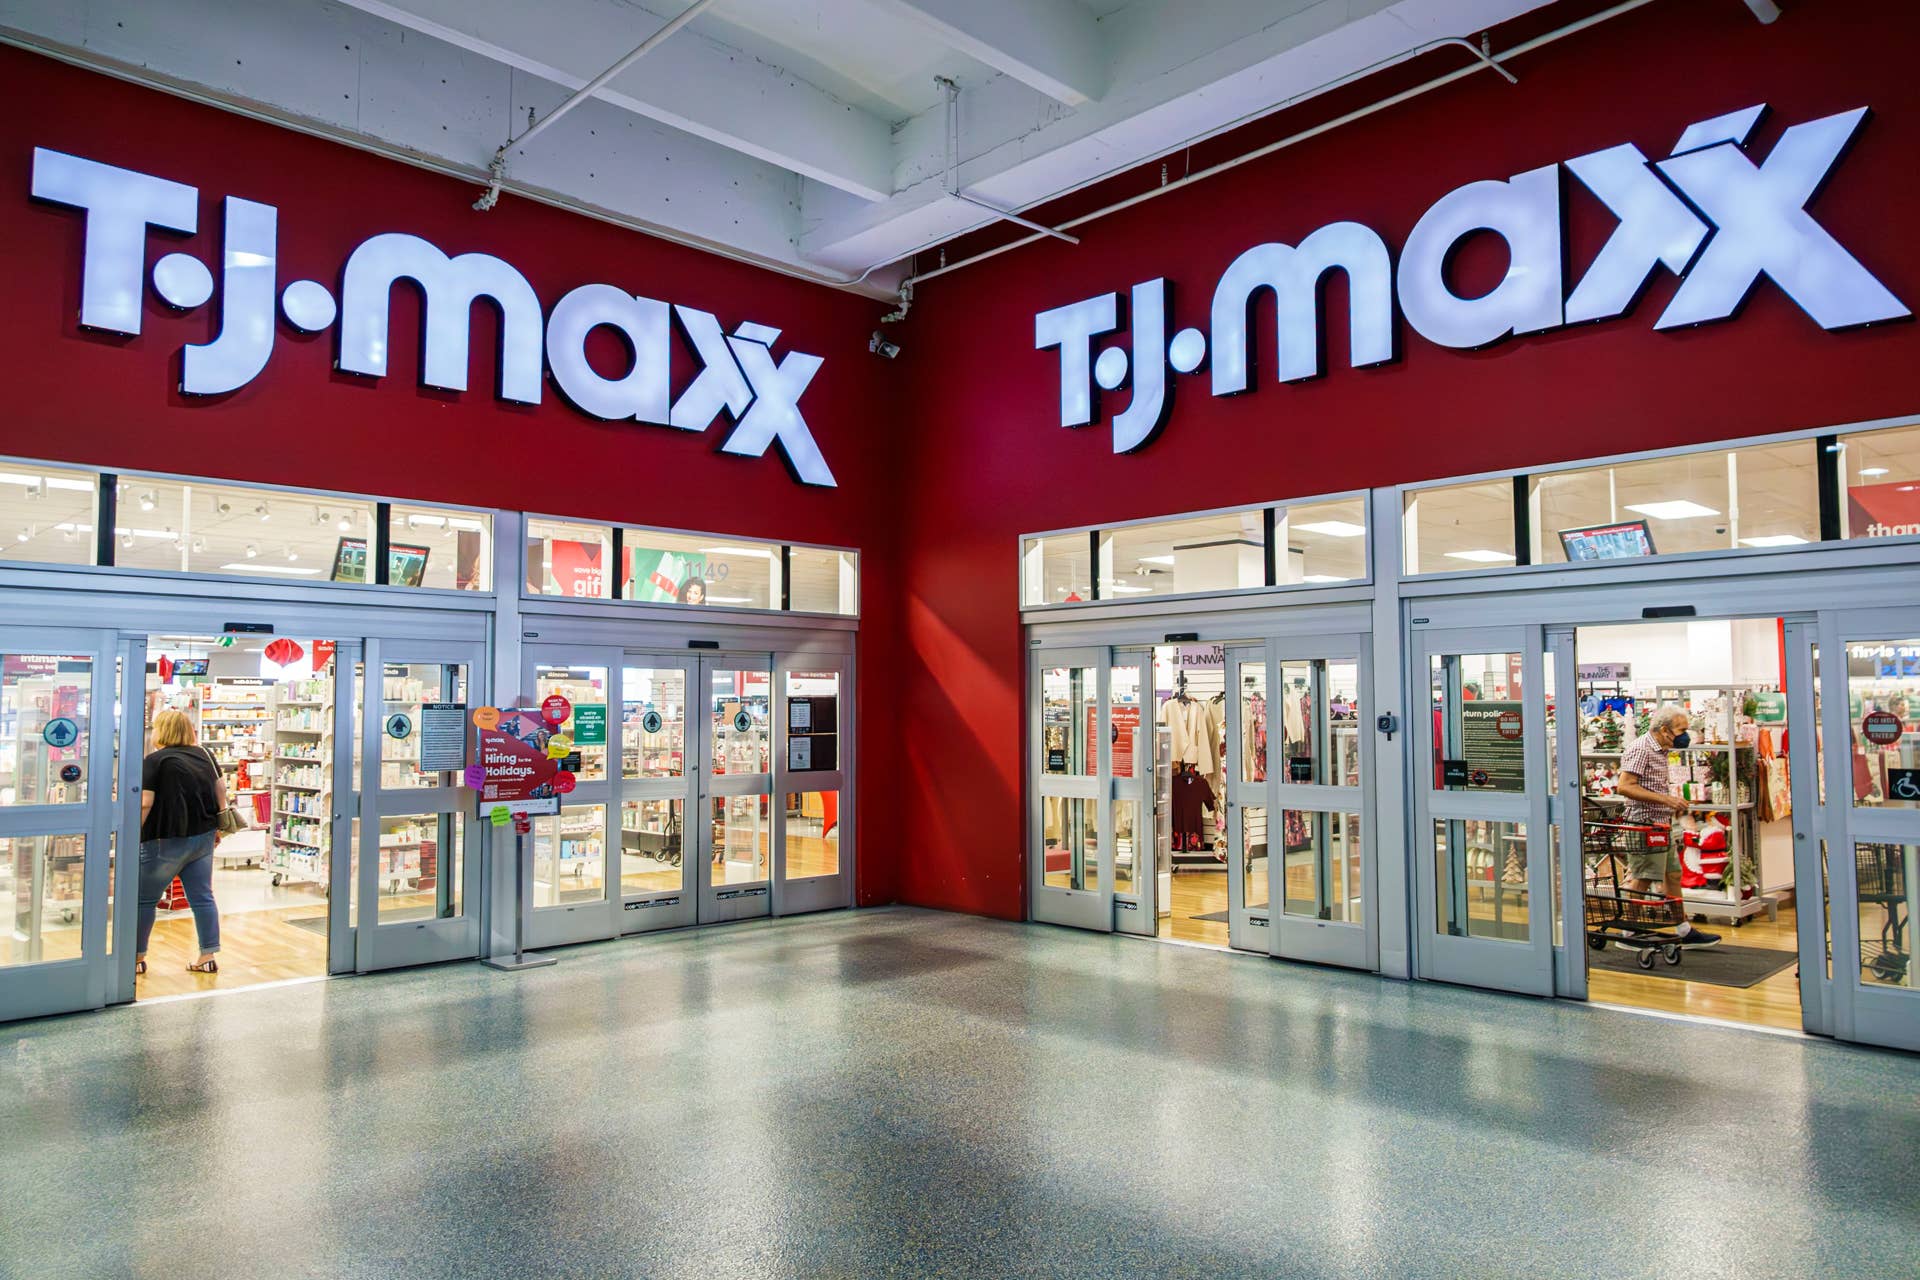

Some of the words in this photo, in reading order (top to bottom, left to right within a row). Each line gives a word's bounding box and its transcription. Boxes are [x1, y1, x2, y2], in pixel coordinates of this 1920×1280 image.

[686, 561, 729, 583] 1149
[485, 753, 517, 765] Hiring
[485, 766, 536, 777] Holidays.
